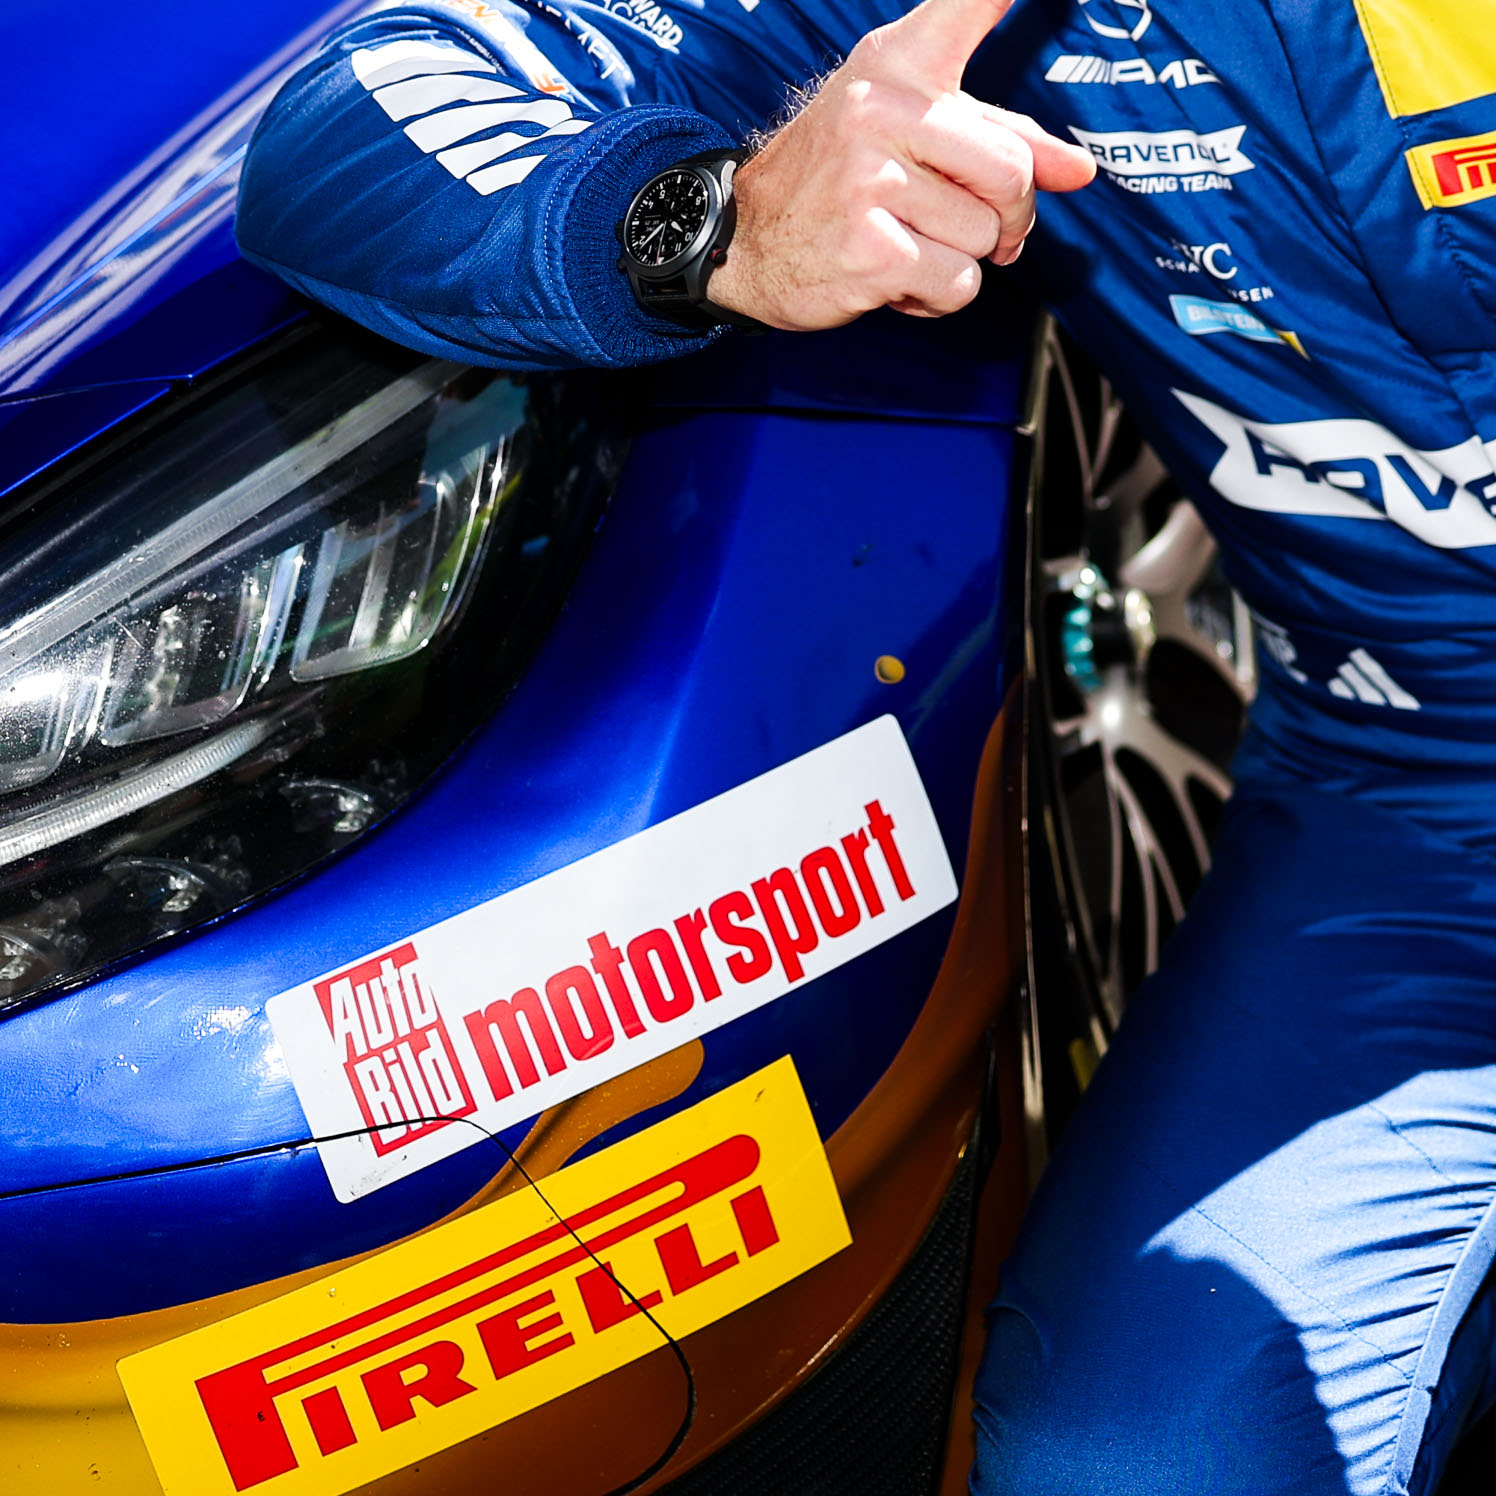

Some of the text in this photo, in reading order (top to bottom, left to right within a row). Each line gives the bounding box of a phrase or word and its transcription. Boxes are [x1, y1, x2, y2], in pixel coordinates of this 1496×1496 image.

[1088, 143, 1231, 163] RAVENOL
[1180, 174, 1233, 192] TEAM
[330, 950, 440, 1062] Auto
[462, 799, 916, 1102] motorsport
[352, 1029, 468, 1154] Bild
[194, 1133, 781, 1492] PIRELLI
